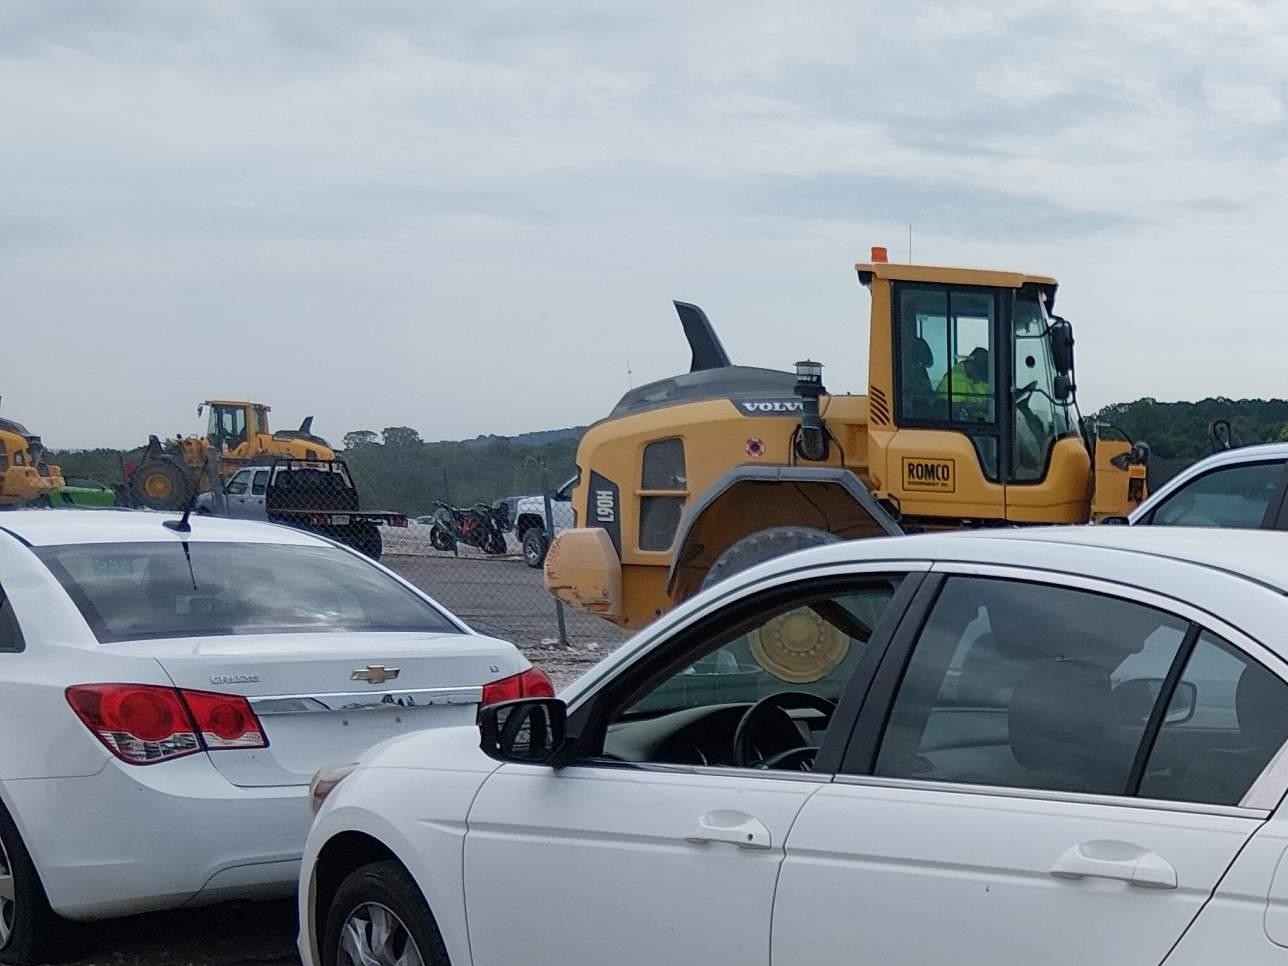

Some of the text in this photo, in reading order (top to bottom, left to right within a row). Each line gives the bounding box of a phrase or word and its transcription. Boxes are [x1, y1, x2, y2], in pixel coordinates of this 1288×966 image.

[742, 402, 804, 412] VOLV
[907, 463, 950, 481] ROMCO
[596, 490, 615, 522] L90H
